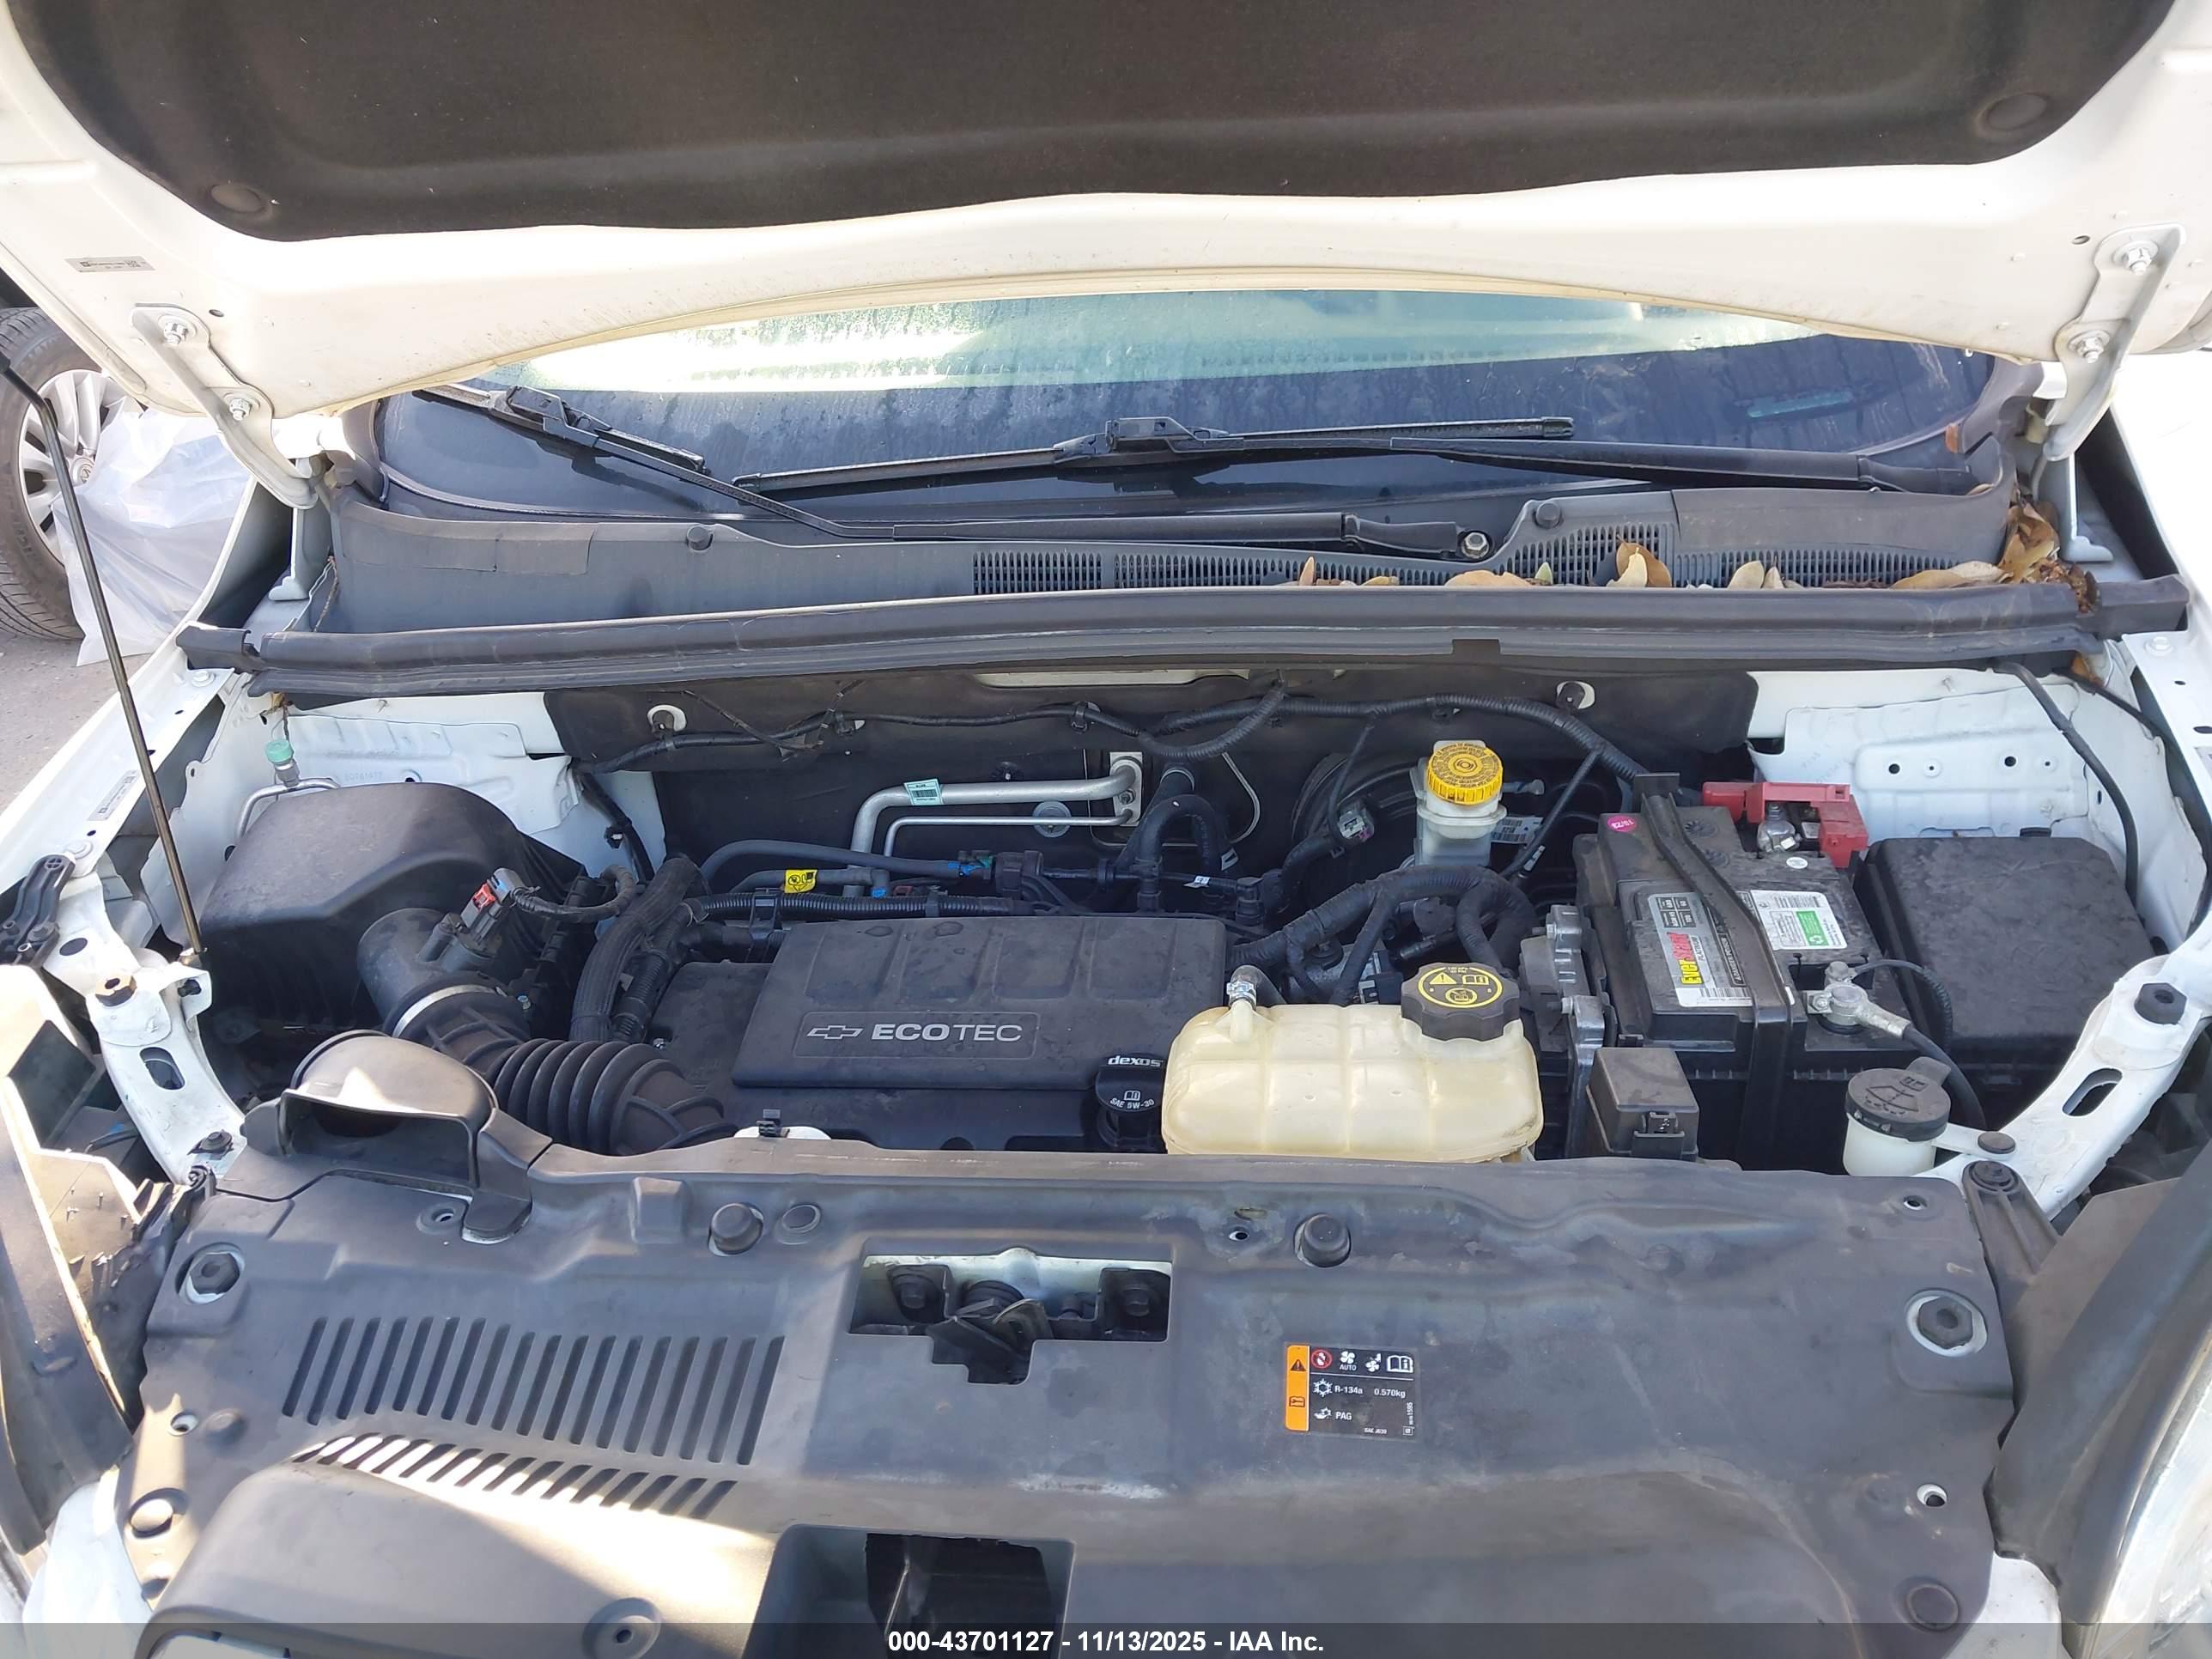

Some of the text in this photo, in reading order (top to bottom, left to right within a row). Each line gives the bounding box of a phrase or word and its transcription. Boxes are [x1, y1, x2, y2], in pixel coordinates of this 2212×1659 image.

[1667, 932, 1704, 984] EverStart
[871, 1023, 1023, 1042] ECOTEC
[1108, 1054, 1163, 1067] dexos
[1109, 1097, 1155, 1109] SAE 5W-30
[1334, 1385, 1407, 1399] R-134a 0.570kg
[1335, 1412, 1352, 1421] PAG
